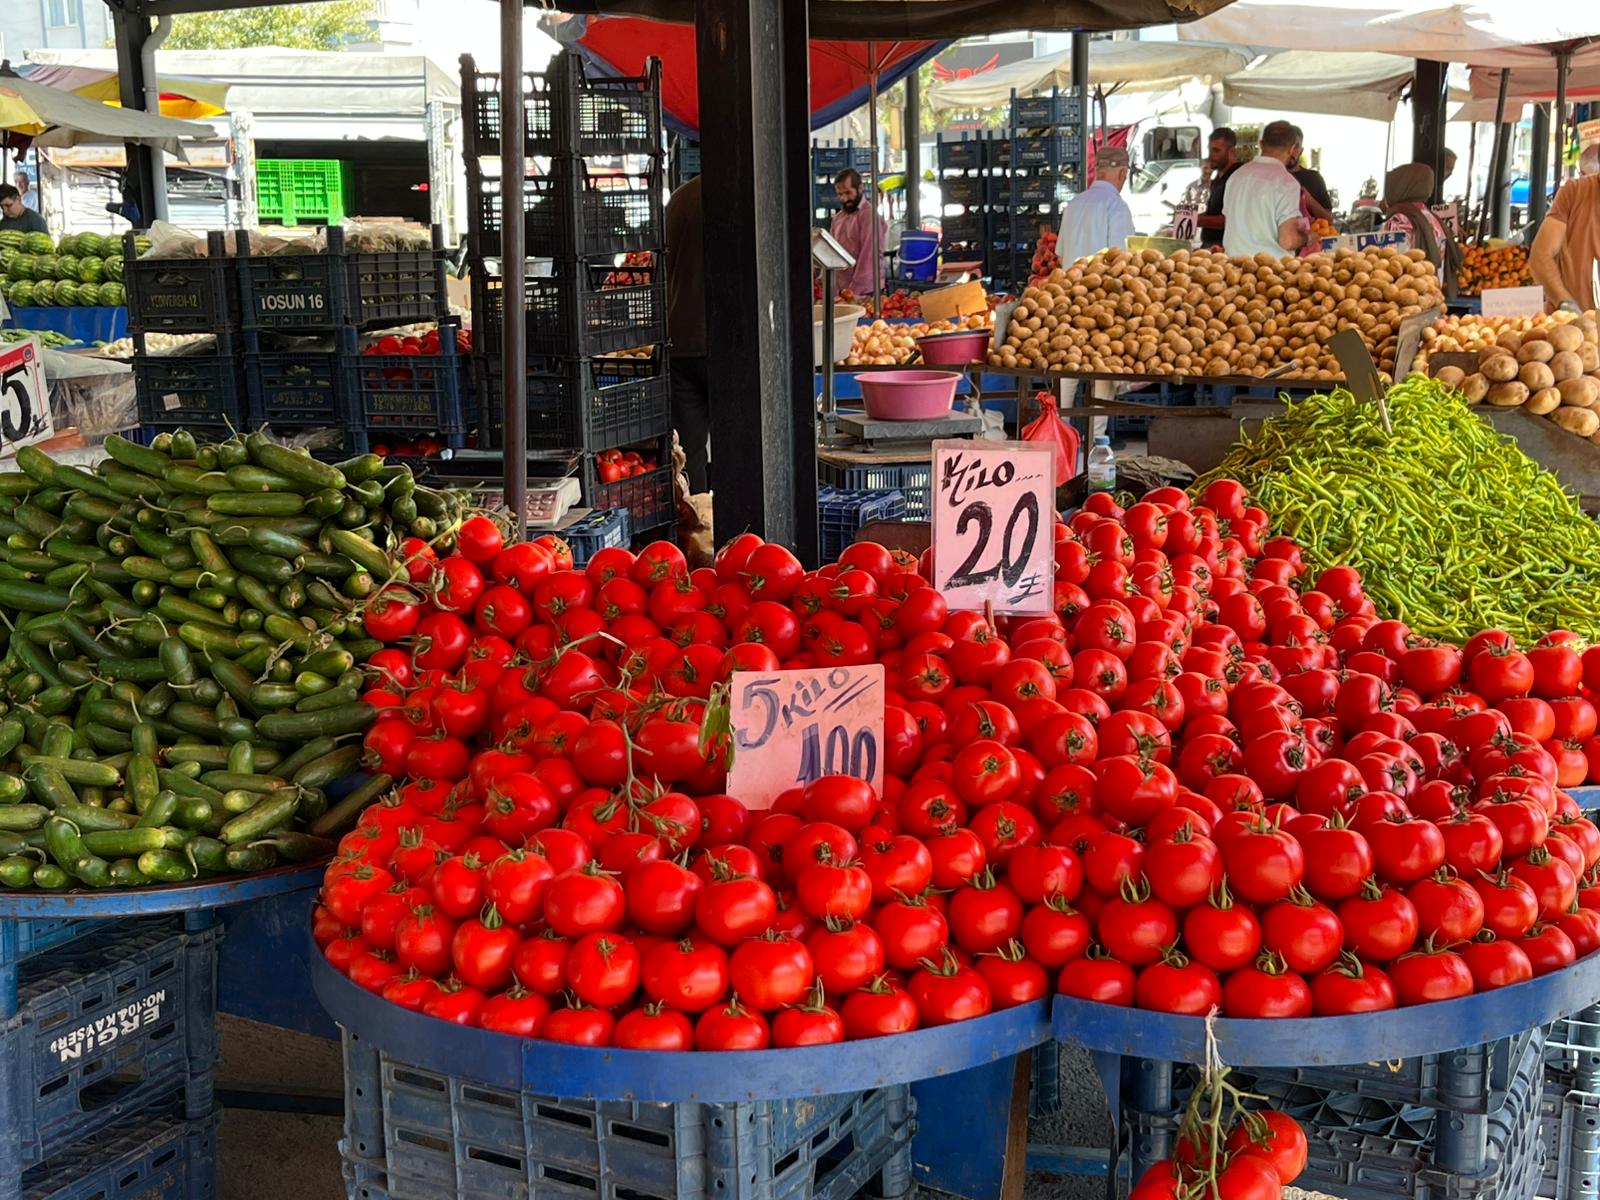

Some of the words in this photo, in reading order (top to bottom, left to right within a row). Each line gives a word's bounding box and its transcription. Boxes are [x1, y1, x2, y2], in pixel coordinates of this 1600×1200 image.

[260, 294, 306, 310] TOSUN
[308, 293, 324, 309] 16
[0, 362, 32, 443] 5
[943, 490, 1040, 592] 20
[735, 678, 781, 752] 5
[796, 722, 877, 786] 100
